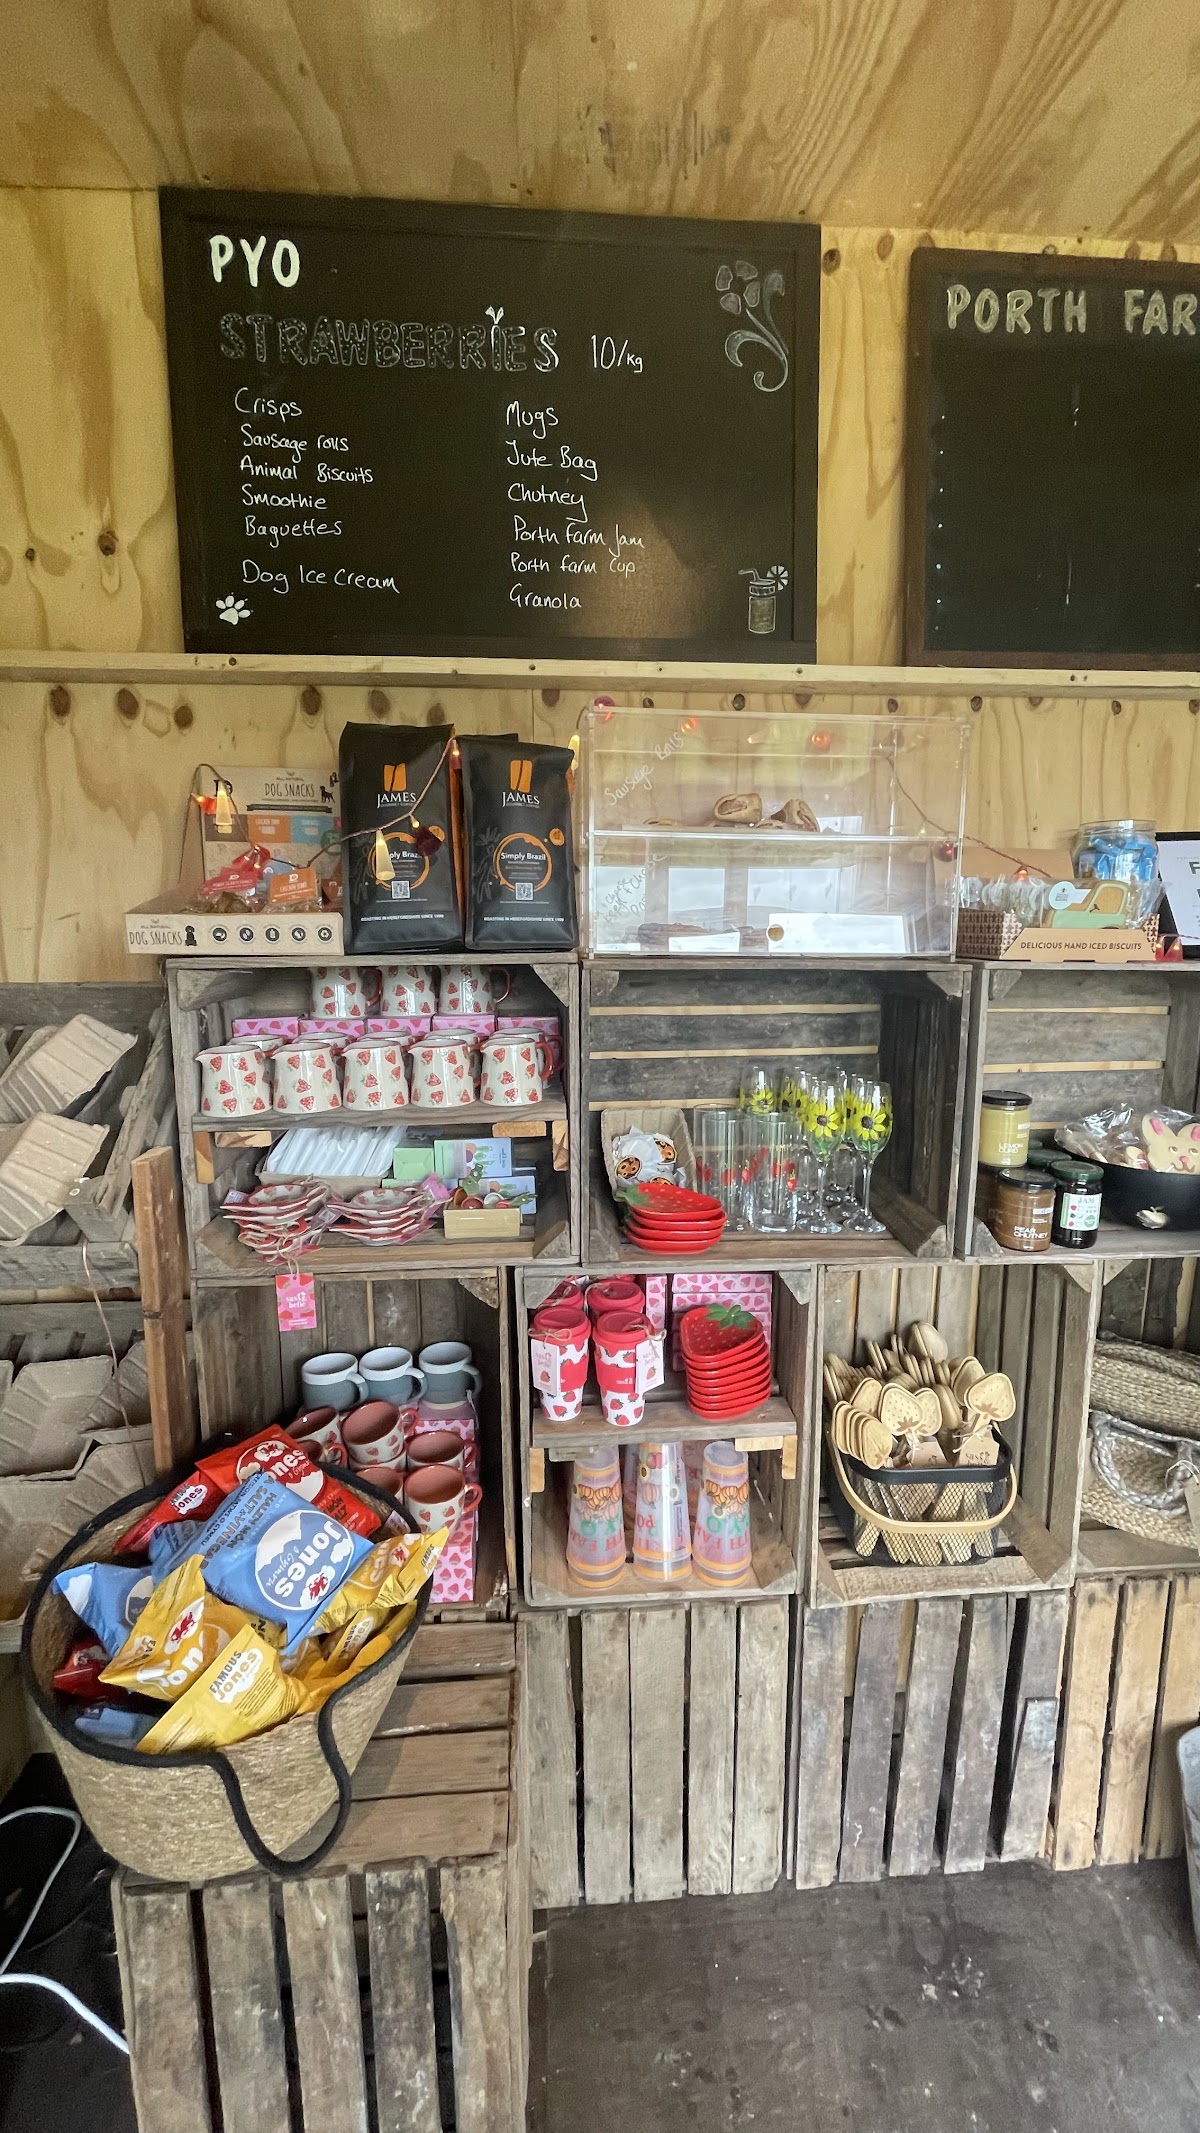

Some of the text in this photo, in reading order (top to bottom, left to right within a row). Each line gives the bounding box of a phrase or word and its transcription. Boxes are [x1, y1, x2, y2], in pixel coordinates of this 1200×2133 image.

[209, 235, 300, 287] PYO
[947, 285, 1086, 334] PORTH
[220, 312, 559, 372] STRAWBERRIES
[234, 387, 303, 423] Crisps
[506, 400, 559, 439] Mugs
[240, 423, 308, 463] Sausage
[240, 455, 373, 484] Animal Biscuits
[505, 439, 598, 482] Jute Bag
[241, 484, 327, 510] Smoothie
[507, 482, 588, 523] Chutney
[245, 515, 342, 548] Baguettes
[513, 514, 560, 545] Porth
[242, 559, 400, 594] Dog Ice Cream
[510, 551, 550, 572] Porth
[509, 582, 582, 609] Granola
[265, 783, 314, 797] DOG SNACKS
[377, 792, 417, 809] JAMES
[502, 792, 540, 807] JAMES
[501, 852, 546, 861] Simply Brazil
[129, 931, 182, 945] DOG SNACKS
[1020, 941, 1142, 950] DELICIOUS HAND ICED BISCUITS
[1013, 1231, 1048, 1239] CHUTNEY
[275, 1521, 341, 1598] Jones
[209, 1650, 242, 1694] FAMOUS
[218, 1651, 258, 1700] Jones
